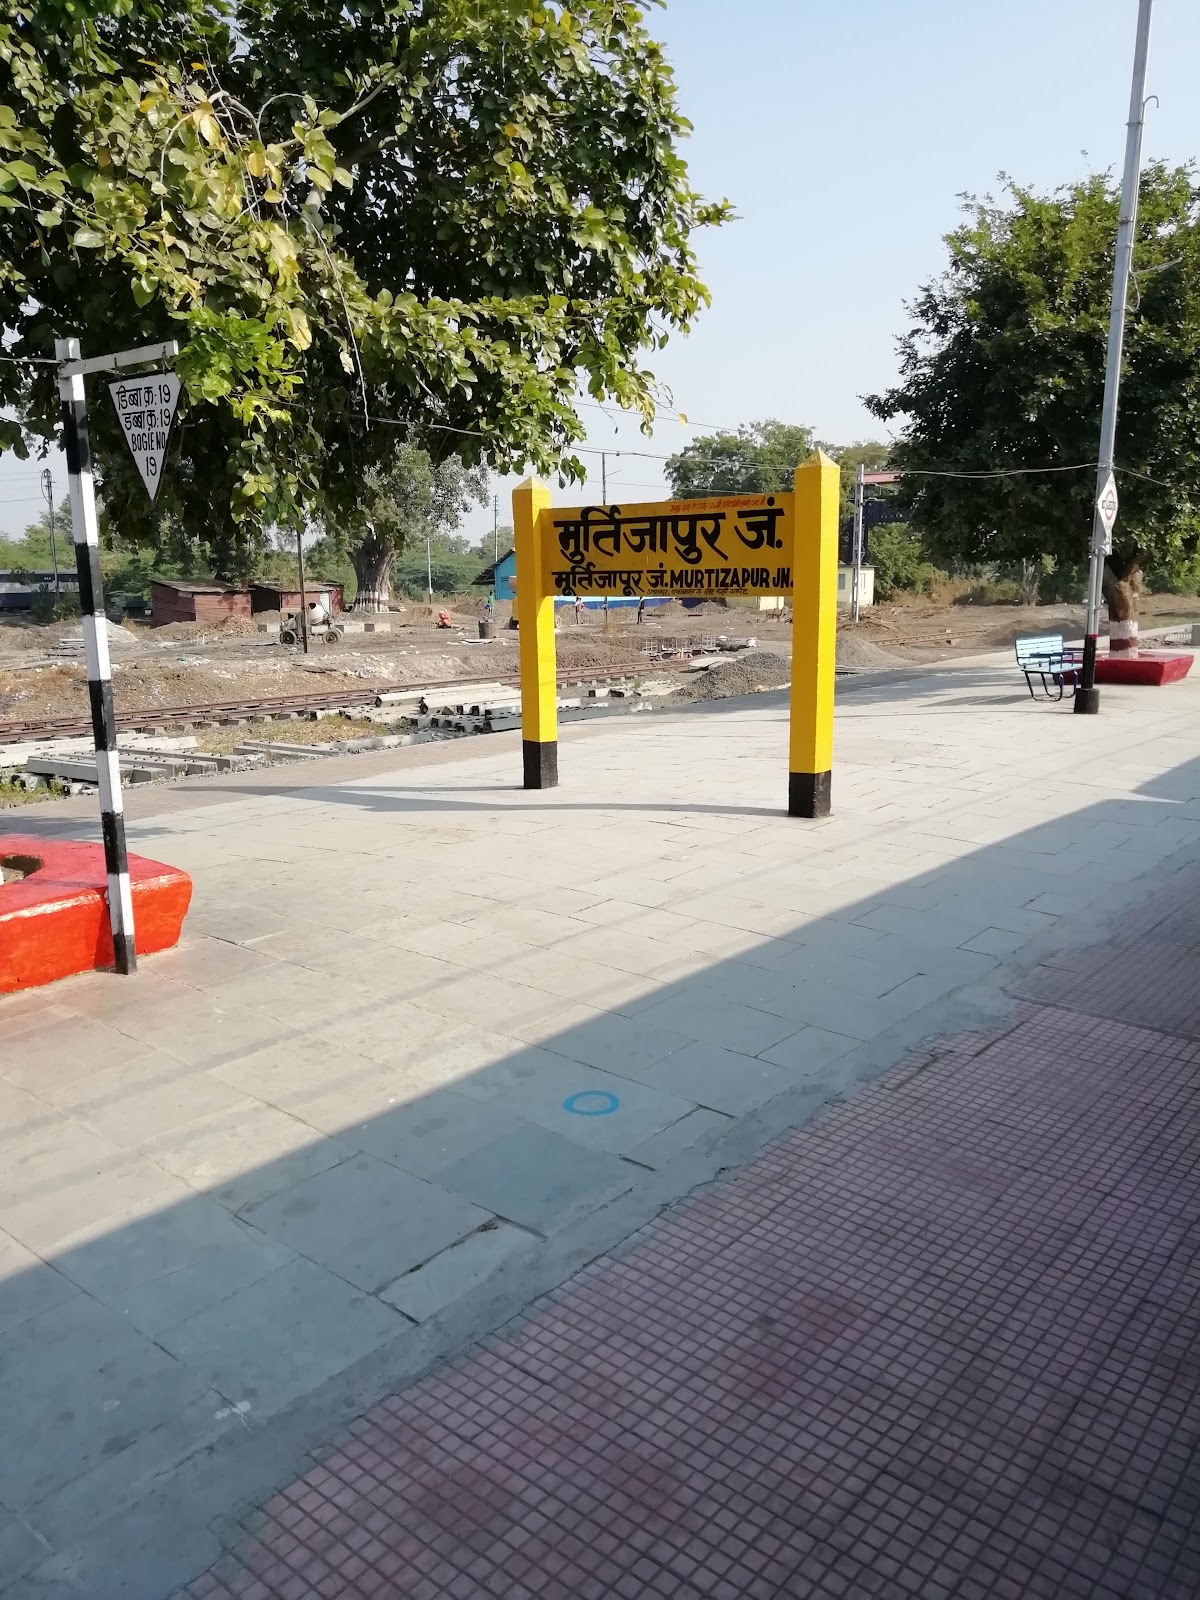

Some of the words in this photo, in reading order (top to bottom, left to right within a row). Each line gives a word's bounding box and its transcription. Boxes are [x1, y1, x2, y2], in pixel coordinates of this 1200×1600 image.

[115, 385, 143, 411] डिब्बा
[158, 384, 171, 404] 19
[122, 411, 145, 431] डब्बा
[160, 408, 171, 427] 19
[131, 432, 155, 452] BOGIE
[156, 431, 166, 450] NO
[145, 456, 158, 477] 19
[553, 505, 729, 565] मुर्तिजापुर
[733, 496, 785, 549] जं.
[551, 561, 645, 596] मूर्तिजापूर
[646, 562, 669, 589] जं.
[670, 567, 770, 589] MURTIZAPUR
